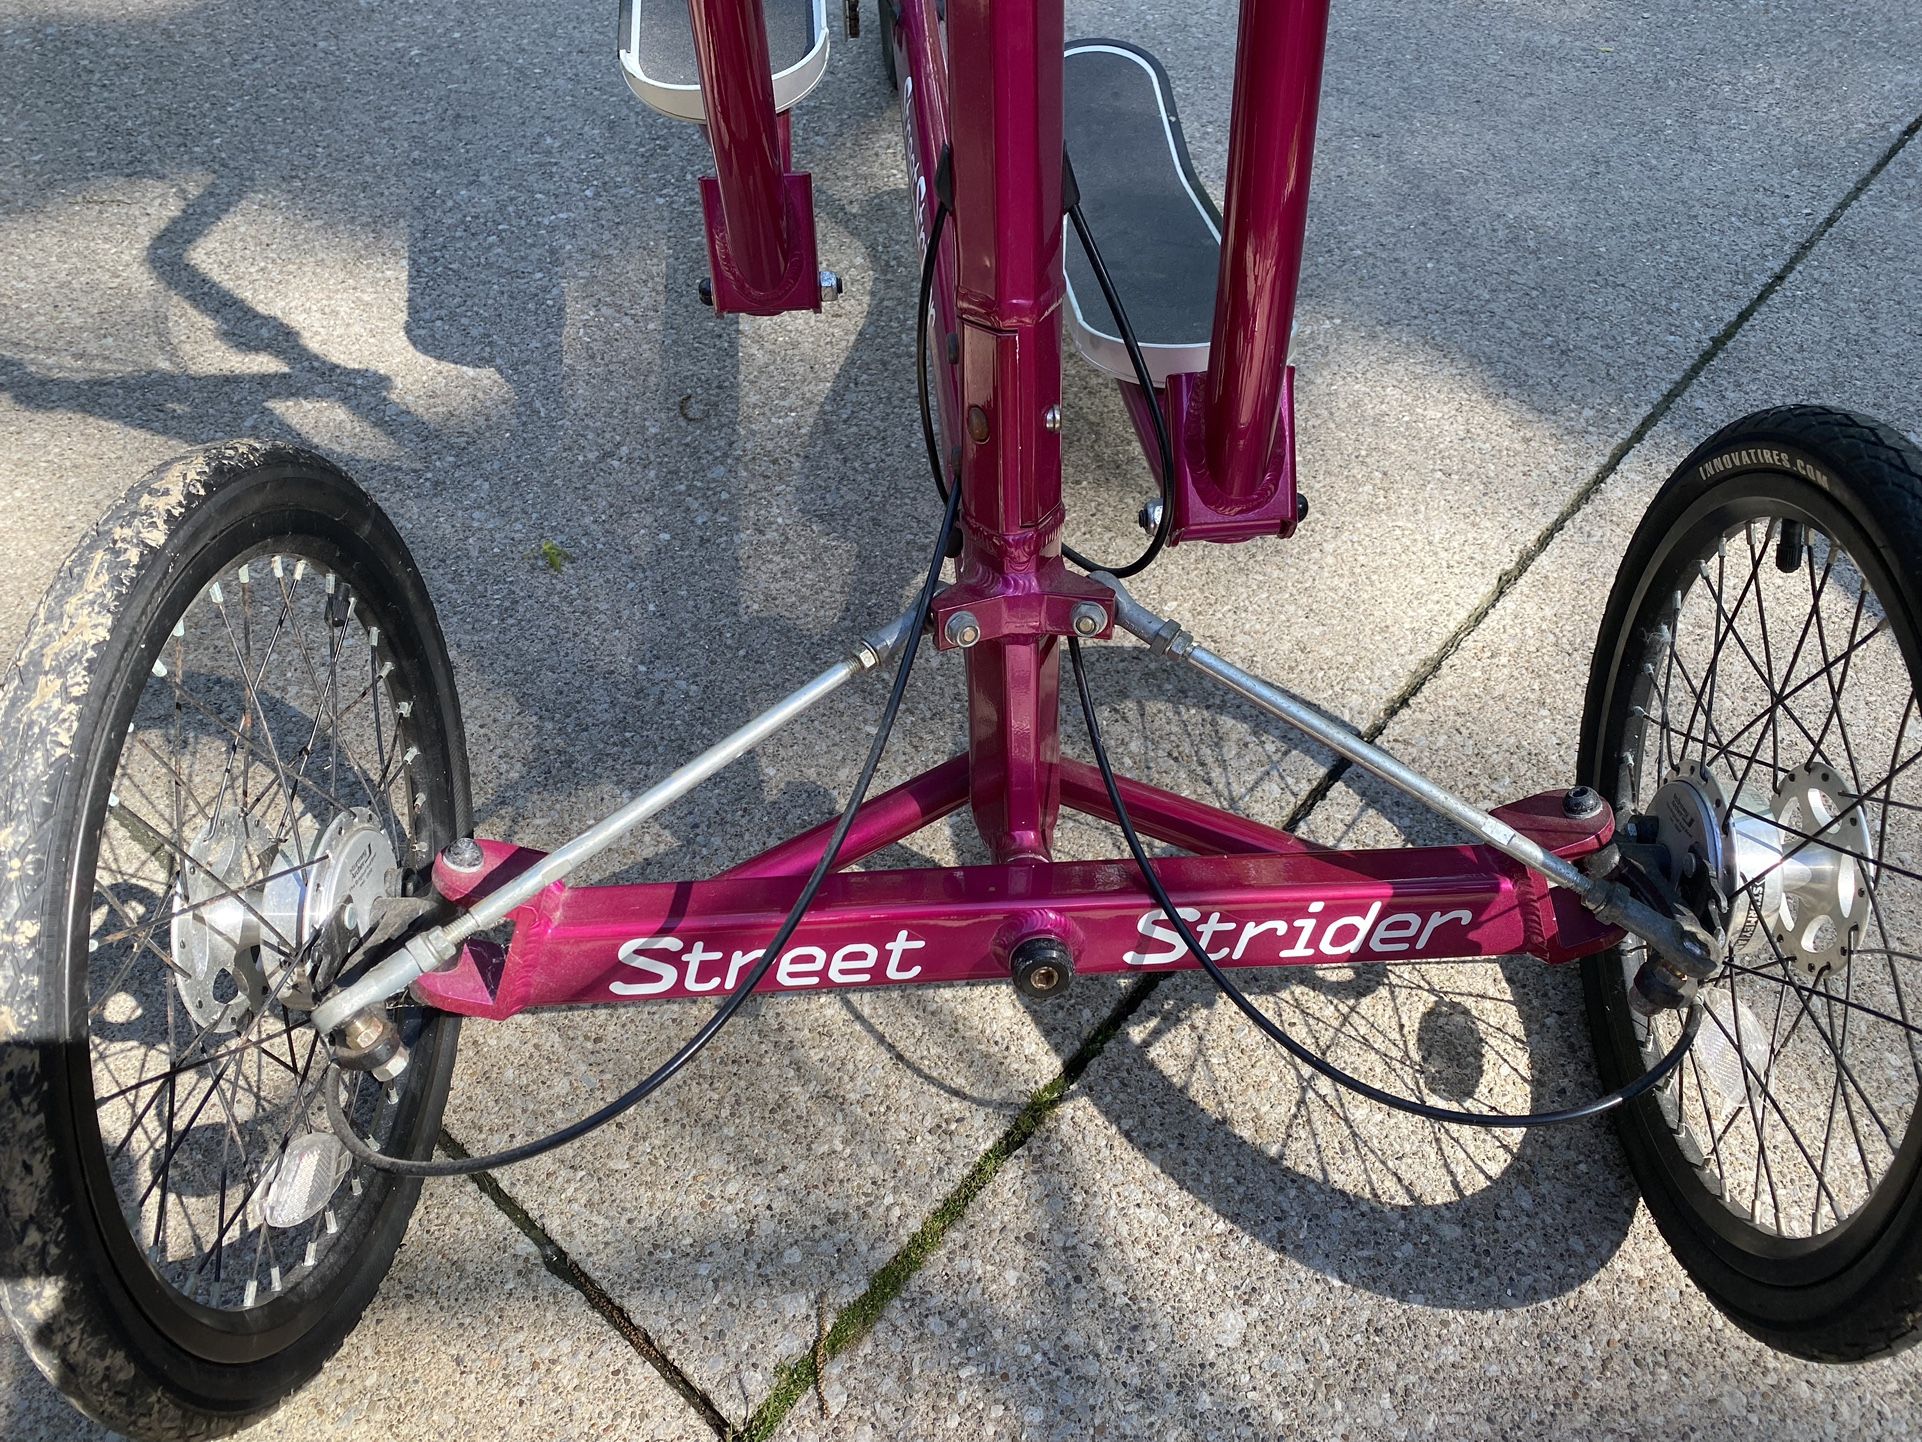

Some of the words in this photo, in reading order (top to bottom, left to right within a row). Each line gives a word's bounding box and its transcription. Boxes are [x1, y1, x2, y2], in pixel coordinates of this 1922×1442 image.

[1698, 448, 1831, 491] INNOVATIRES.COM
[608, 929, 926, 996] Street
[1122, 901, 1473, 965] Strider
